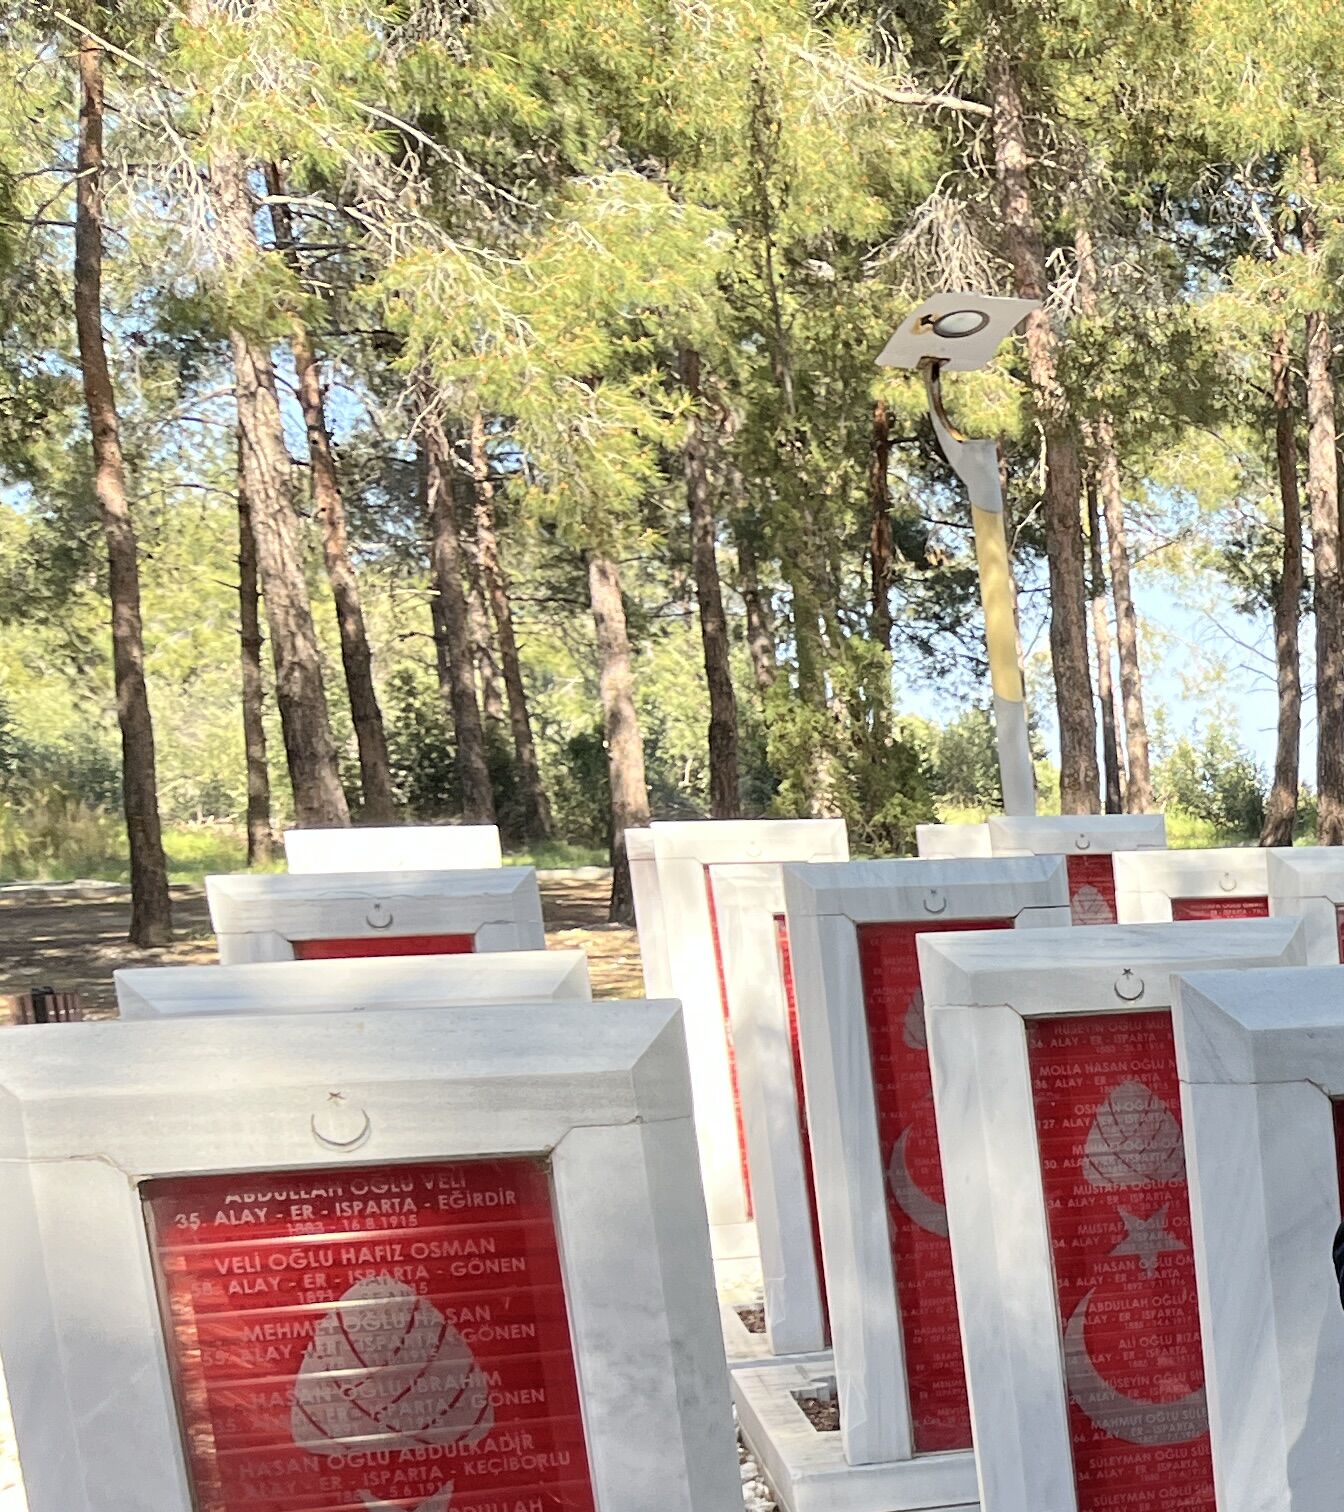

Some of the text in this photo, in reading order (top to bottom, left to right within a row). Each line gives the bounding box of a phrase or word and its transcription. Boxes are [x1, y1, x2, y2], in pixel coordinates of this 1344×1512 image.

[214, 1206, 268, 1226] ALAY
[290, 1205, 314, 1221] ER
[336, 1198, 417, 1217] ISPARTA
[438, 1188, 517, 1210] EĞİRDİR
[214, 1252, 261, 1275] VELİ
[268, 1249, 333, 1271] OĞLU
[411, 1237, 496, 1260] OSMAN
[228, 1277, 280, 1296] ALAY
[304, 1273, 328, 1289] ER
[451, 1257, 526, 1278] GÖNEN
[460, 1322, 536, 1344] GÖNEN
[471, 1387, 545, 1409] GÖNEN
[319, 1451, 571, 1491] ER ISPARTA KEÇİBORLU
